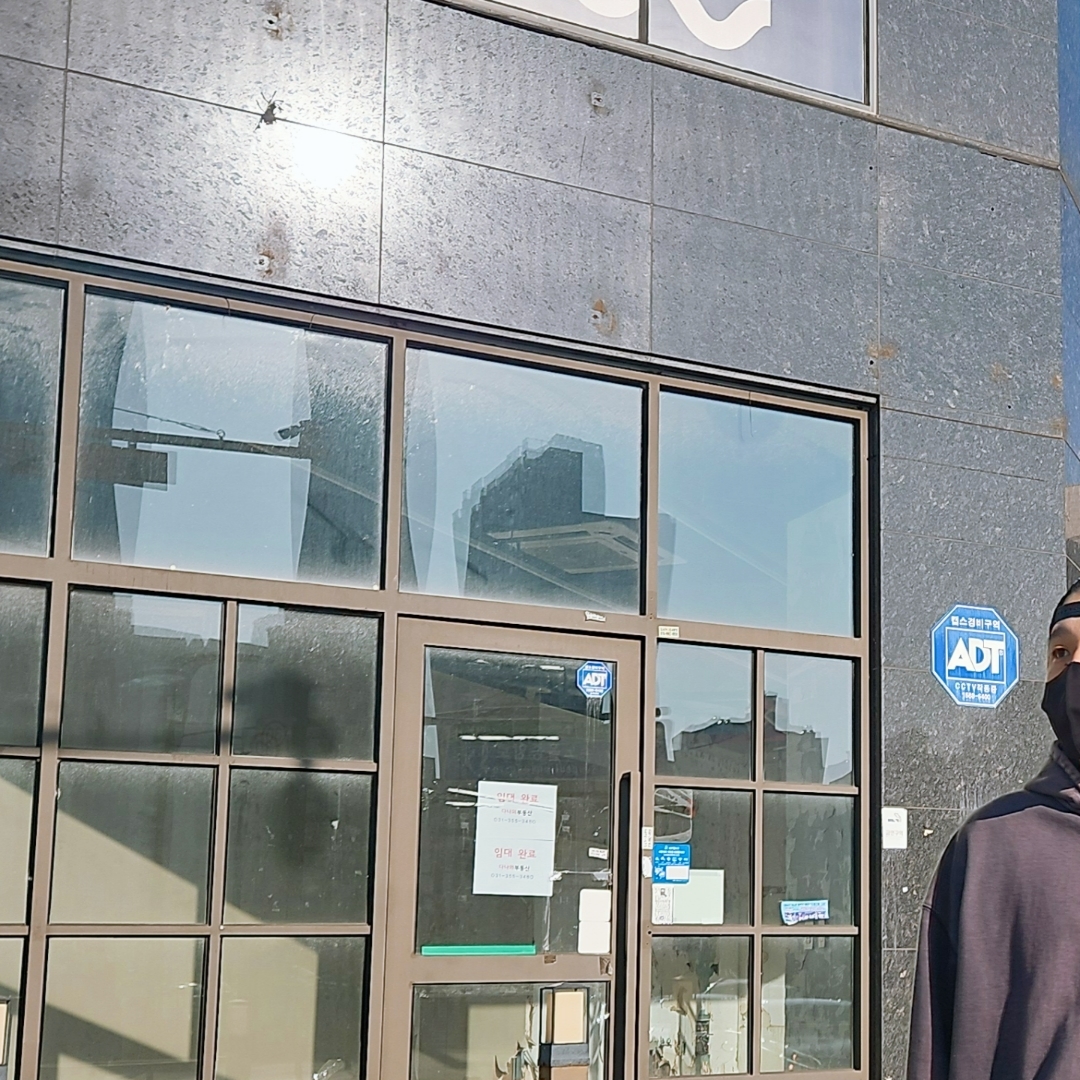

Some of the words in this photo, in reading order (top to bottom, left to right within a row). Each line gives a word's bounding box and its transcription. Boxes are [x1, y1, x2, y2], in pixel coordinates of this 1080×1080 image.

[947, 638, 1004, 675] ADT
[584, 671, 608, 687] ADT
[496, 792, 515, 803] 임대
[520, 793, 539, 804] 완료
[494, 847, 513, 859] 임대
[517, 848, 537, 859] 완료
